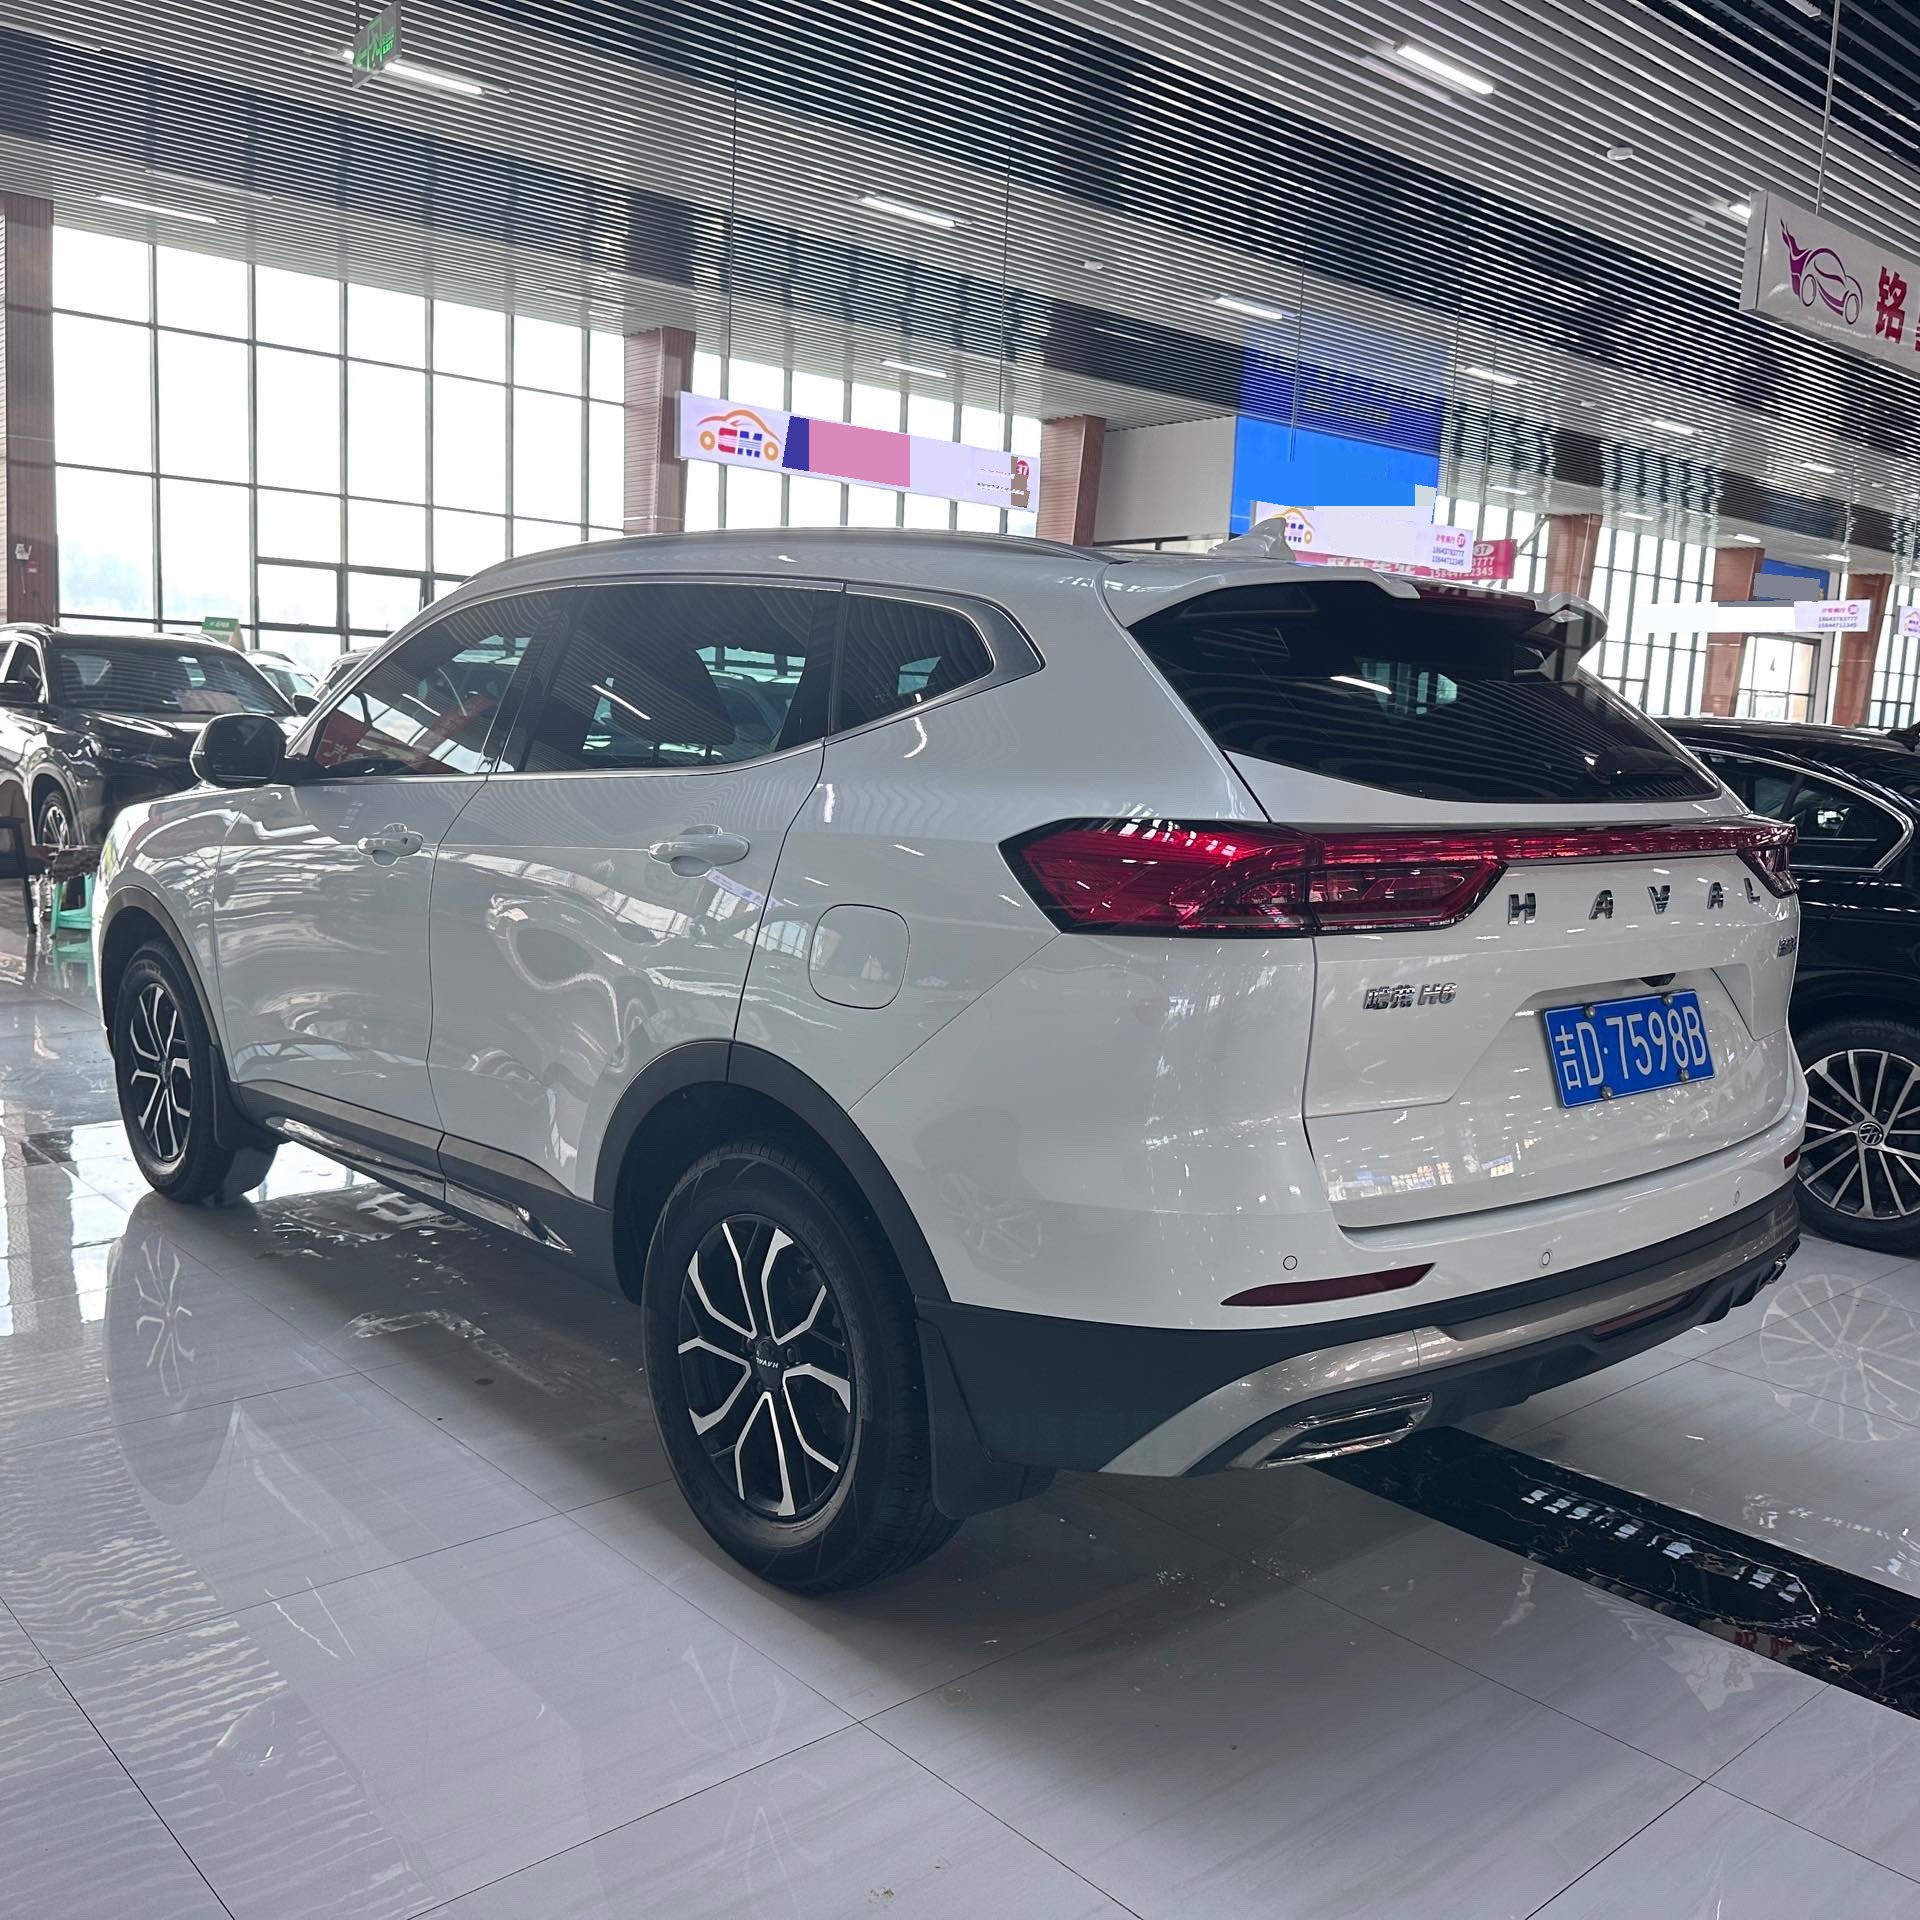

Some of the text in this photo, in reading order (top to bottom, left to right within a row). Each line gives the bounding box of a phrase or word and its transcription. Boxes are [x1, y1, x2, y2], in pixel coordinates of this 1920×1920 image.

[1876, 265, 1920, 351] 铭
[1475, 545, 1489, 555] 37
[1430, 567, 1494, 578] 158442345
[1508, 877, 1761, 926] HAVAL
[1417, 982, 1458, 1006] H6
